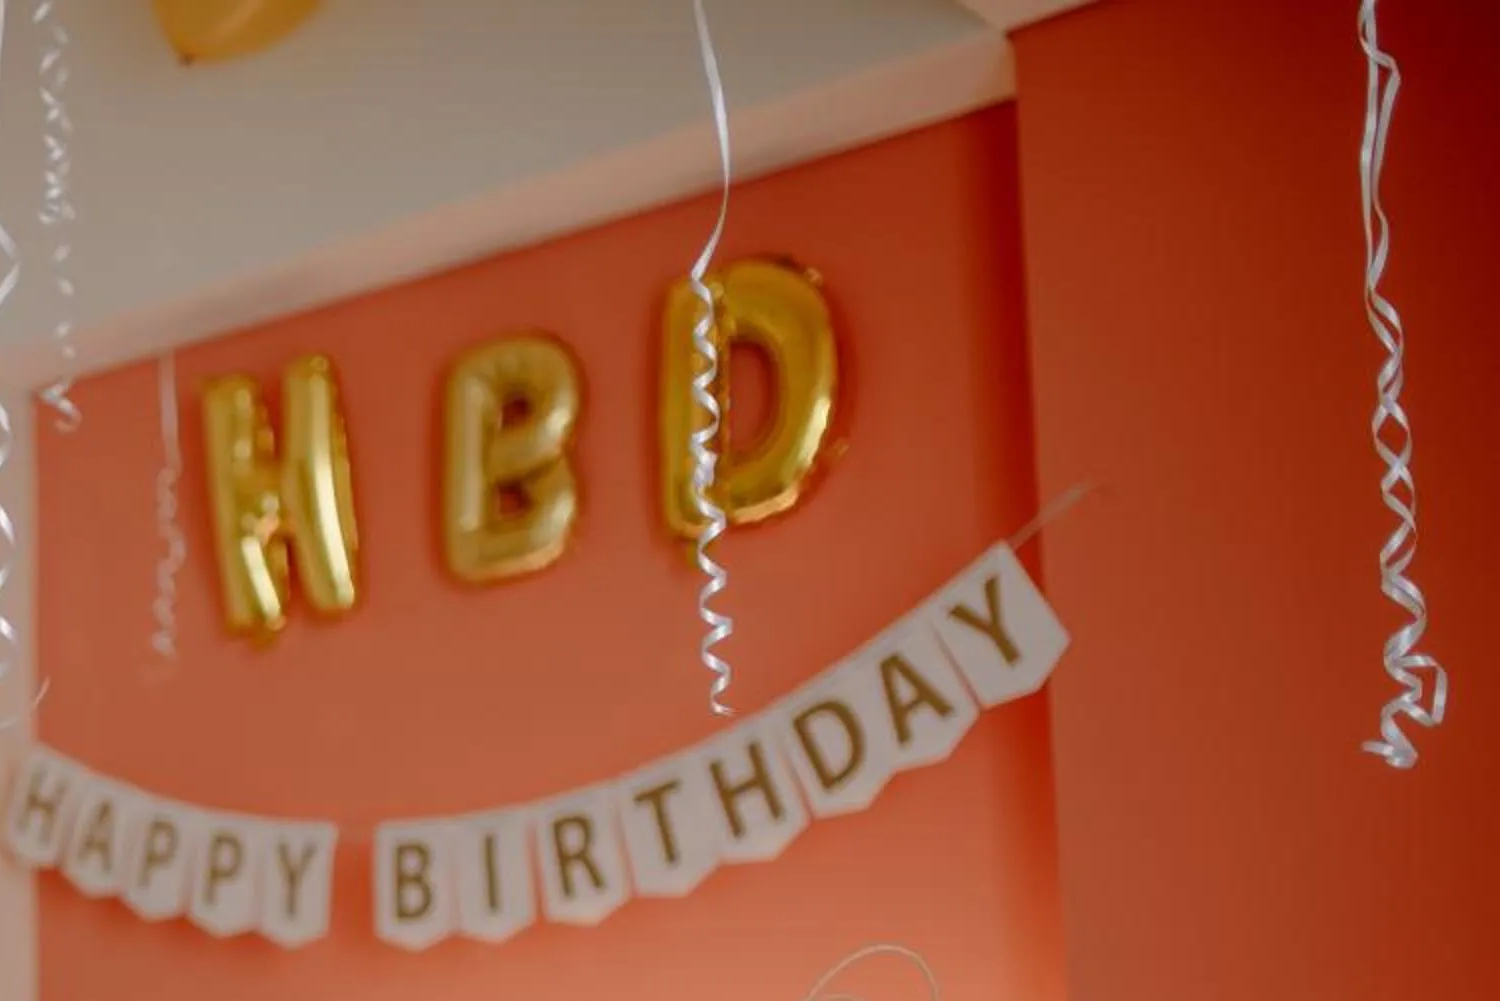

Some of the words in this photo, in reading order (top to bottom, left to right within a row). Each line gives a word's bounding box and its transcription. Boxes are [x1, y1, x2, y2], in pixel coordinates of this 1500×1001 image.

[204, 258, 844, 642] HBD
[14, 764, 318, 922] HAPPY
[393, 574, 1022, 924] BIRTHDAY
